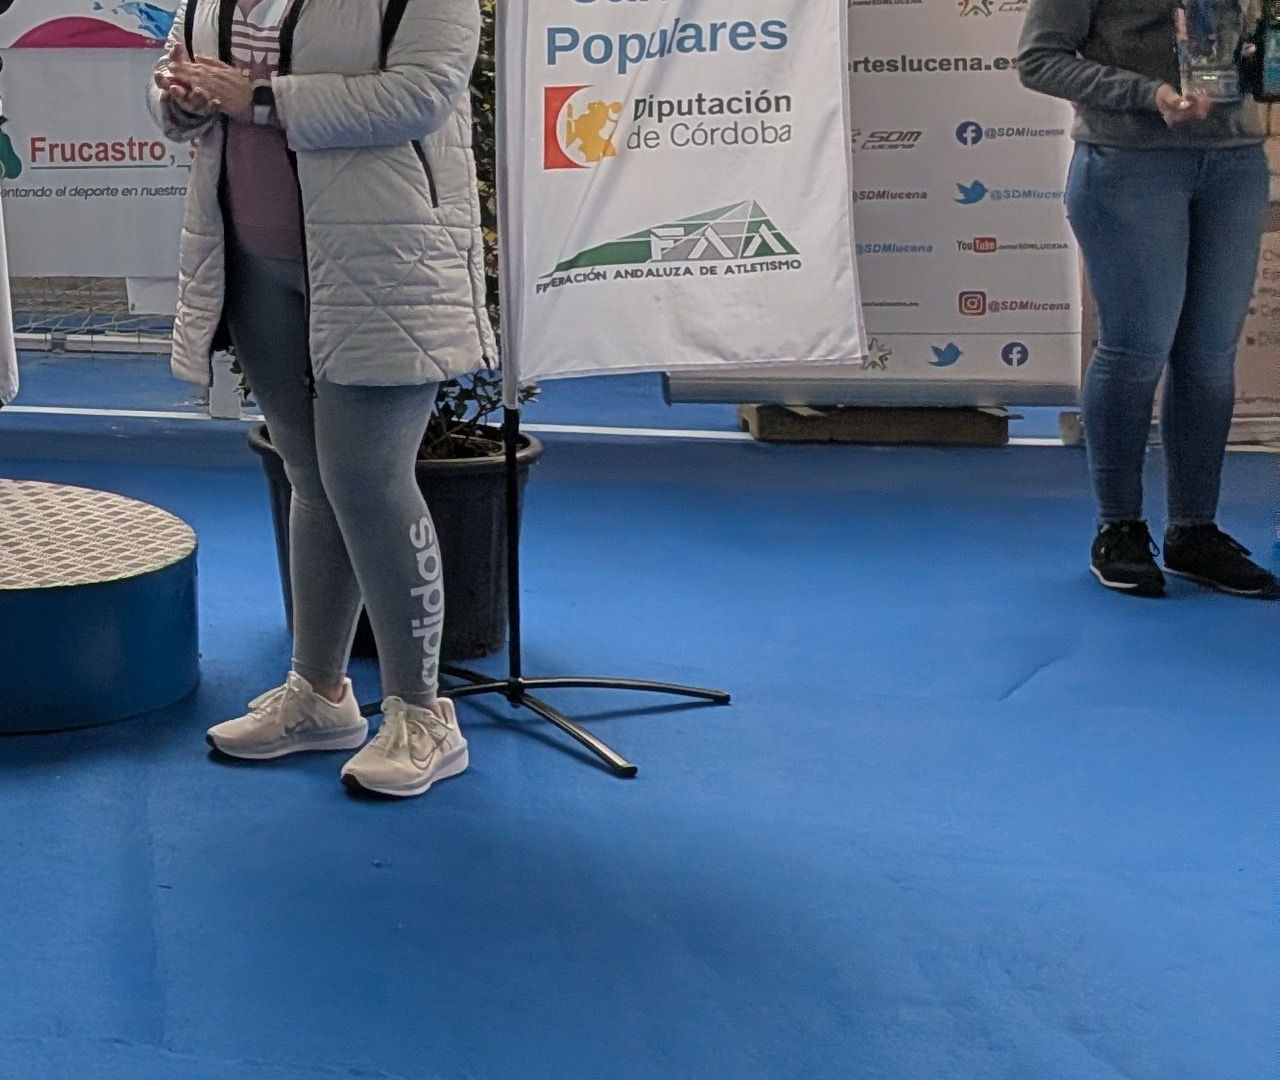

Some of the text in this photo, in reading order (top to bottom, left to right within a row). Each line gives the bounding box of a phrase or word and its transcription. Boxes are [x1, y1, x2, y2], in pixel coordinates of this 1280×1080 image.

[545, 17, 789, 75] Populares
[633, 89, 792, 123] Diputación
[626, 121, 792, 150] de Córdoba
[30, 136, 176, 166] Frucastro,
[1, 187, 187, 200] entando el deporte en nuestra
[613, 265, 693, 280] ANDALUZA
[700, 265, 717, 276] DE
[724, 260, 801, 276] ATLETISMO
[410, 516, 444, 686] adidas
